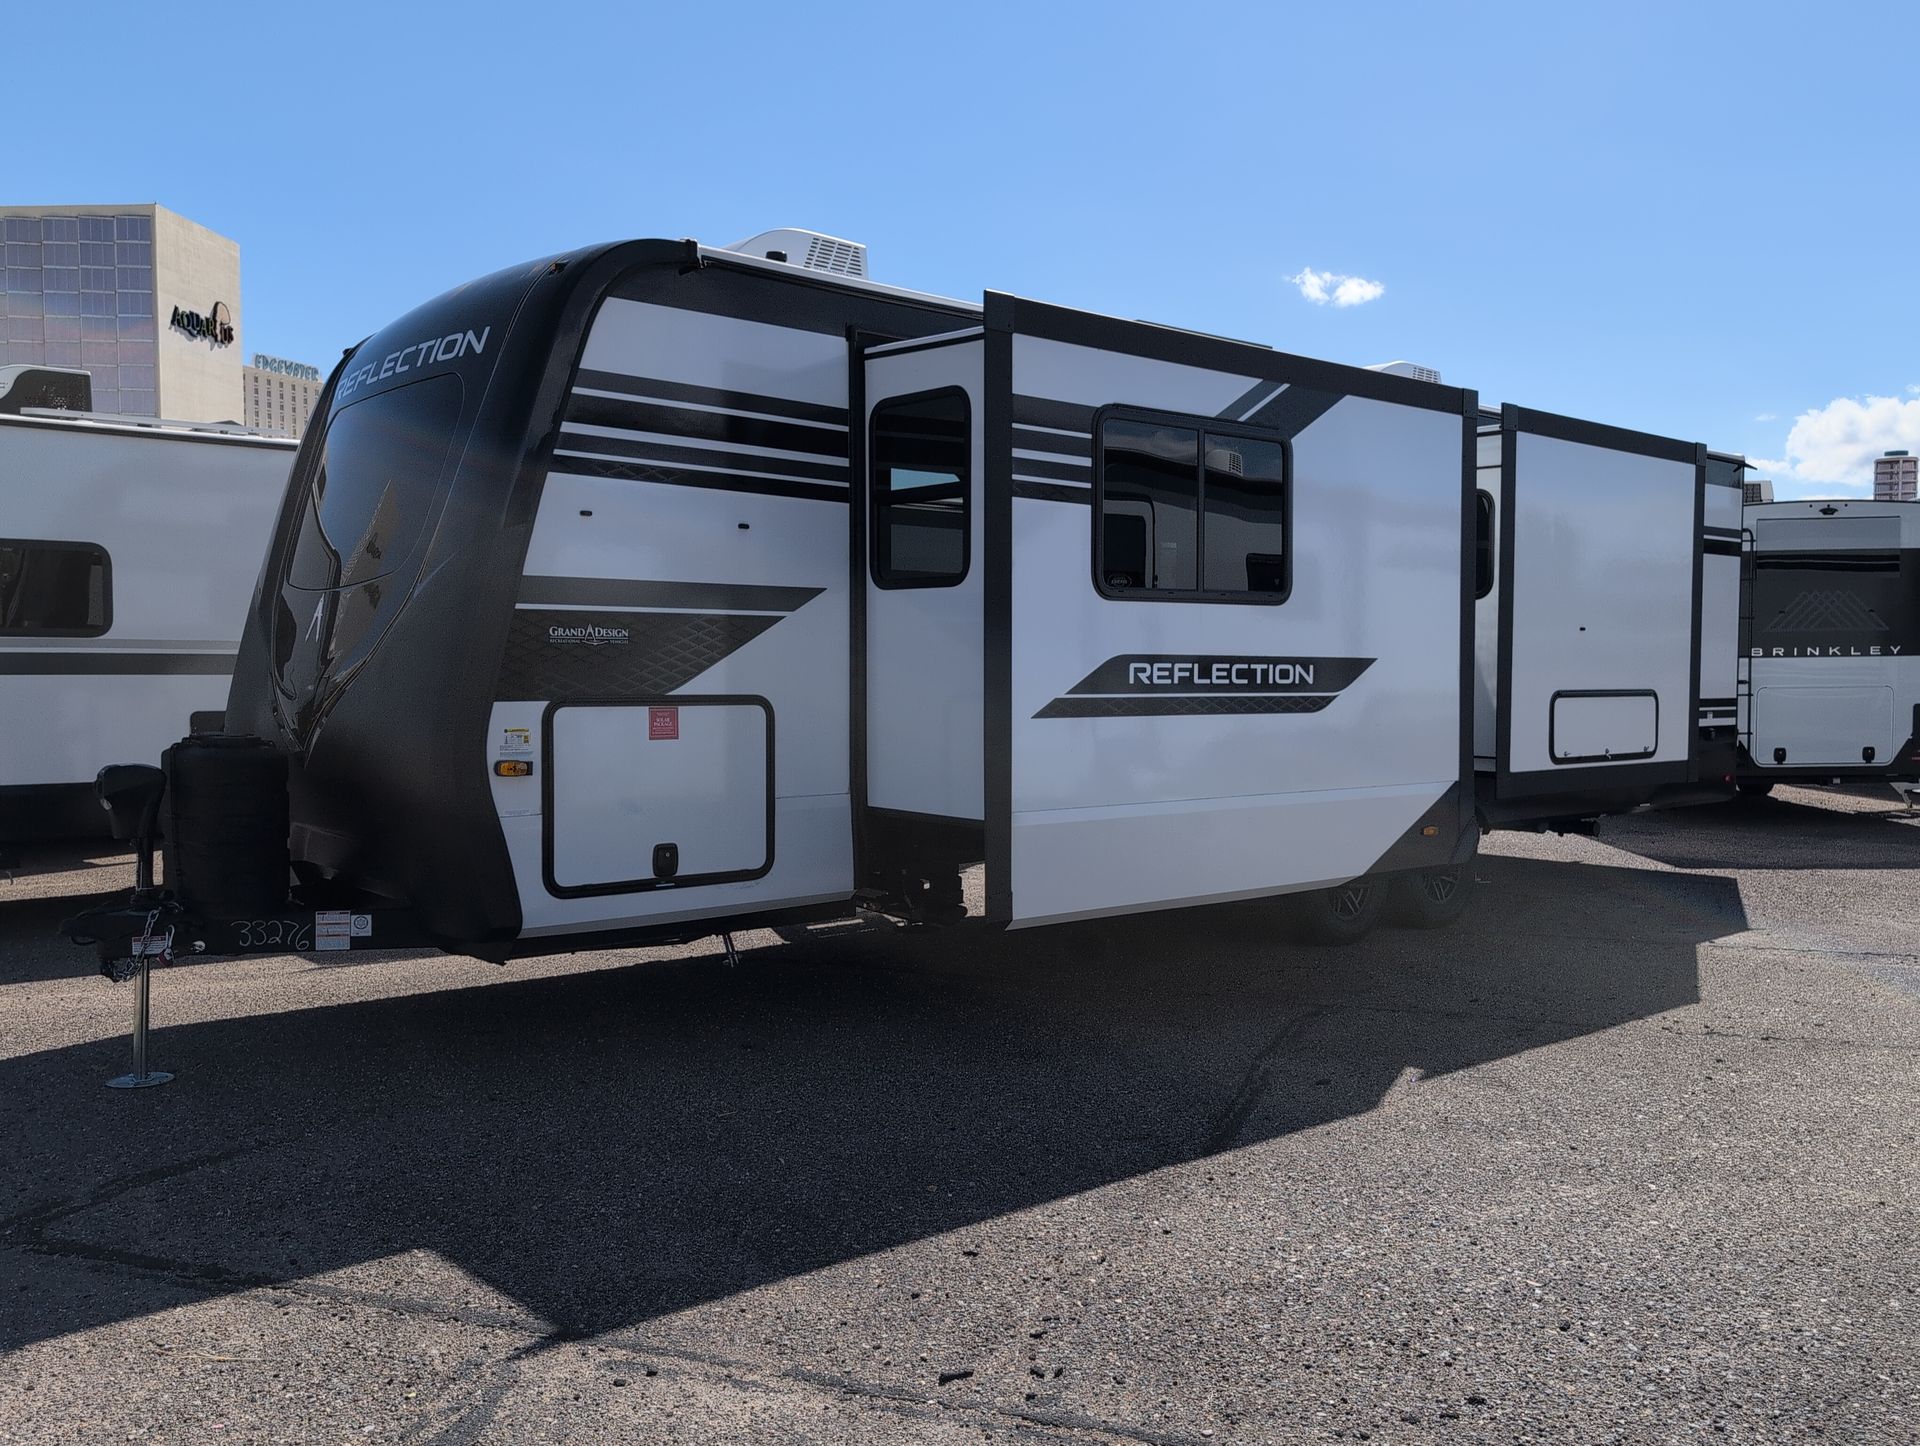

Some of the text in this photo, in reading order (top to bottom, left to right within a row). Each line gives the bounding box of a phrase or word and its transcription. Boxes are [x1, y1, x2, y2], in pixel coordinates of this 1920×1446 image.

[171, 302, 235, 345] AQUARIUS
[254, 354, 319, 381] EDGEWATER
[336, 326, 491, 400] REFLECTION
[549, 626, 629, 637] GRAND DESIGN
[1750, 645, 1902, 657] BRINKLEY
[1129, 662, 1315, 685] REFLECTION
[230, 920, 312, 951] 33276
